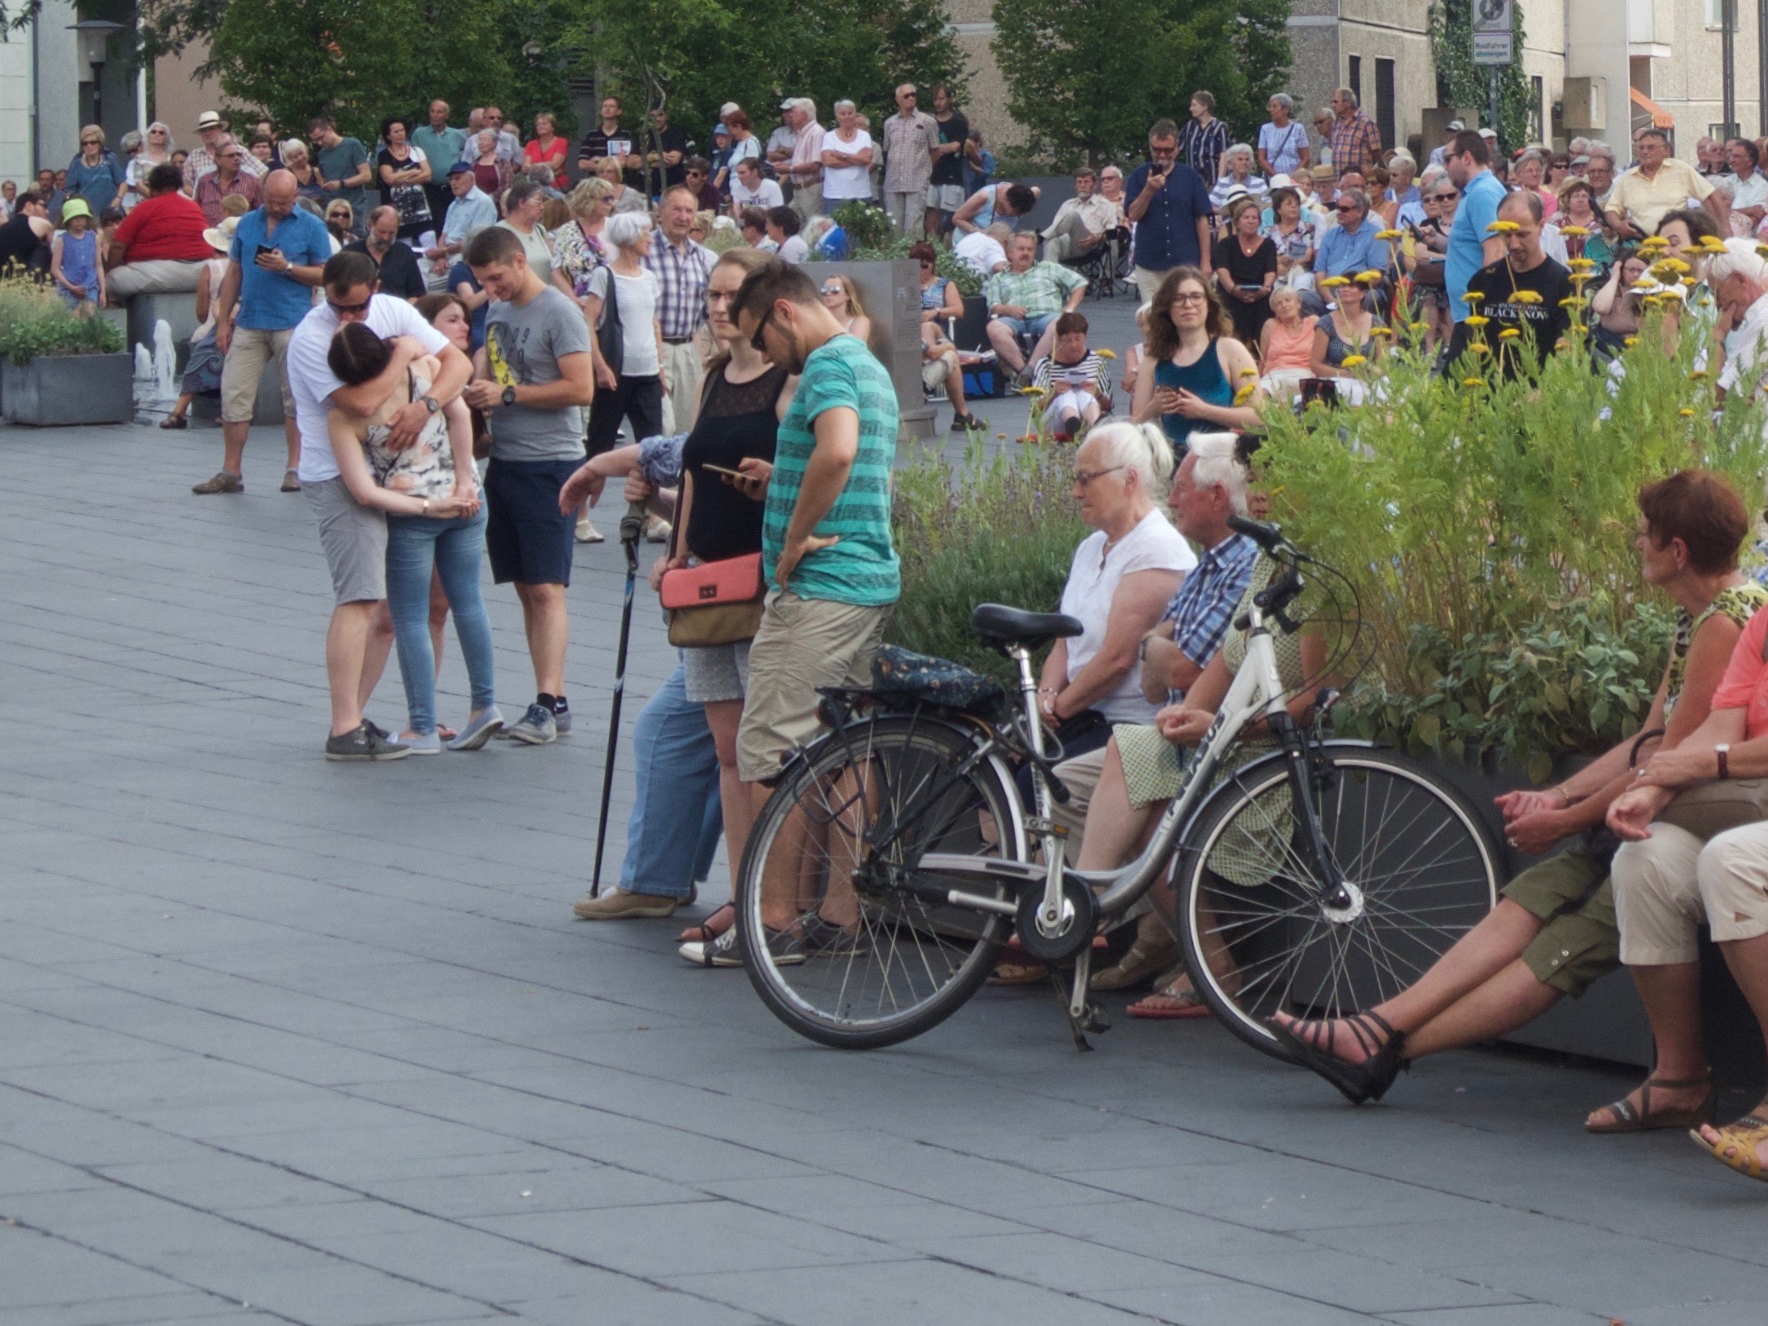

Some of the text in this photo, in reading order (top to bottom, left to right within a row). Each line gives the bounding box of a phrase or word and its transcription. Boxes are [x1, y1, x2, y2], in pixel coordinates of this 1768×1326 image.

[1475, 42, 1509, 50] Radfahrer
[1475, 50, 1508, 59] absteigen
[1484, 305, 1518, 319] BLACK
[1519, 308, 1550, 321] NOW
